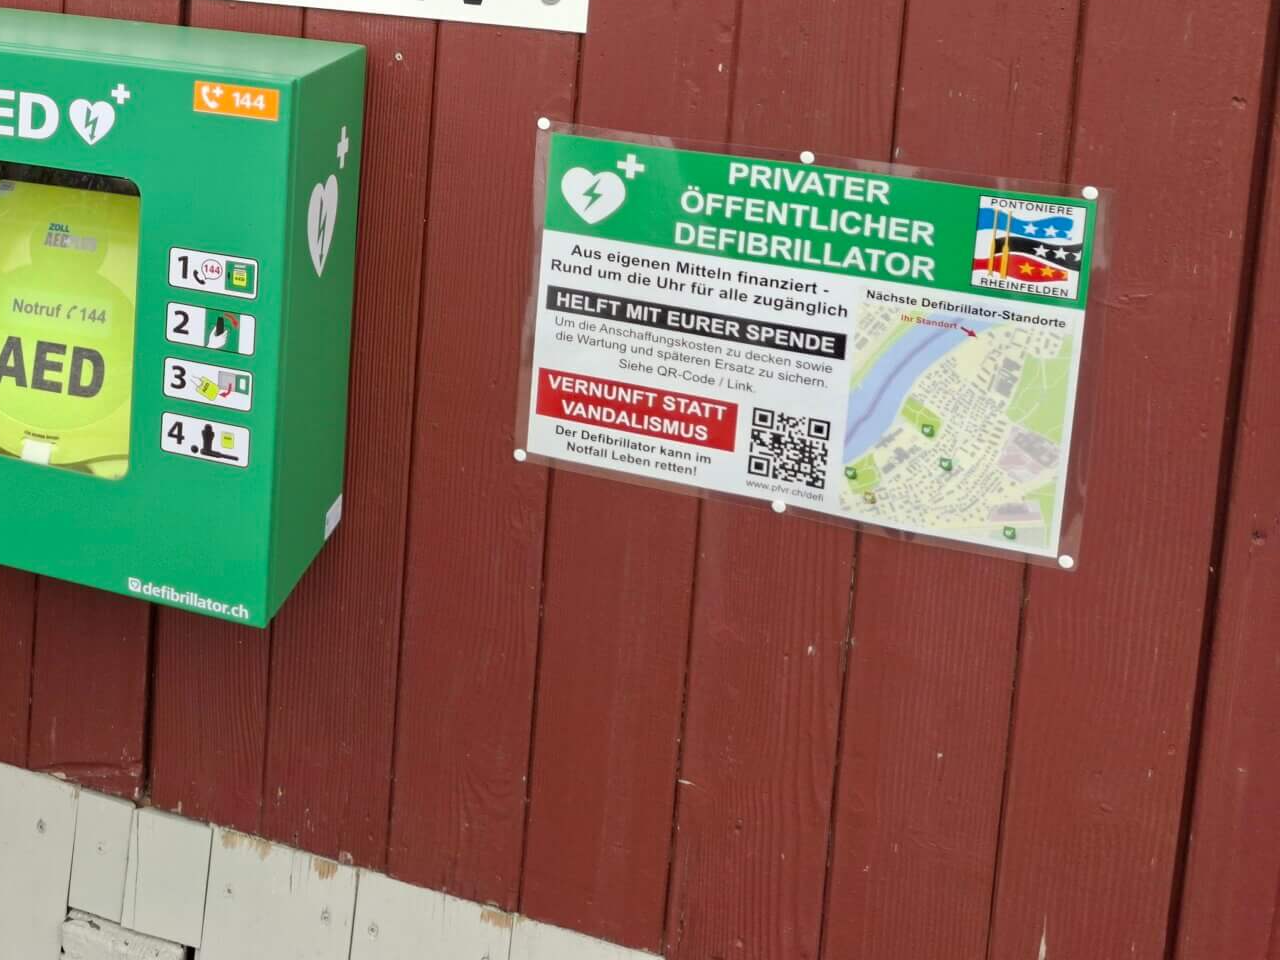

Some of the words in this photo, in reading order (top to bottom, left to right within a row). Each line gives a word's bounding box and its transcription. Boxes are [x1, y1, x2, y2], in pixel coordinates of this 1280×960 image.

[232, 91, 266, 110] 144
[728, 162, 890, 205] PRIVATER
[680, 185, 935, 247] ÖFFENTLICHER
[990, 198, 1074, 216] PONTONIERE
[178, 255, 189, 279] 1
[204, 263, 221, 275] 144
[571, 245, 602, 260] Aus
[607, 251, 670, 273] eigenen
[677, 260, 732, 281] Mitteln
[737, 271, 818, 294] finanziert
[674, 222, 936, 282] DEFIBRILLATOR
[551, 259, 592, 276] Rund
[598, 268, 621, 281] um
[627, 271, 651, 286] die
[657, 275, 686, 291] Uhr
[691, 282, 713, 297] für
[719, 286, 748, 302] alle
[753, 293, 848, 318] zugänglich
[980, 278, 1069, 297] RHEINFELDEN
[12, 298, 62, 318] Notruf
[80, 308, 107, 324] 144
[173, 310, 189, 334] 2
[556, 292, 621, 316] HELFT
[625, 302, 662, 323] MIT
[667, 310, 740, 338] EURER
[745, 325, 836, 353] SPENDE
[866, 289, 918, 307] Nächste
[922, 297, 1067, 328] Defibrillator-Standorte
[916, 316, 959, 330] Standort
[554, 316, 575, 329] Um
[578, 320, 596, 332] die
[599, 322, 722, 355] Anschaffungskosten
[726, 346, 741, 357] zu
[744, 347, 791, 365] decken
[795, 359, 833, 374] sowie
[555, 330, 573, 342] die
[577, 333, 627, 353] Wartung
[630, 341, 653, 356] und
[657, 346, 711, 368] späteren
[715, 359, 754, 376] Ersatz
[758, 368, 773, 378] zu
[777, 369, 828, 388] sichern.
[170, 365, 187, 389] 3
[619, 358, 654, 374] Siehe
[657, 364, 716, 387] QR-Code
[548, 374, 658, 408] VERNUNFT
[662, 394, 727, 421] STATT
[167, 421, 185, 445] 4
[561, 400, 709, 441] VANDALISMUS
[555, 425, 577, 438] Der
[581, 429, 656, 455] Defibrillator
[660, 446, 692, 462] kann
[696, 451, 712, 465] im
[566, 442, 608, 459] Notfall
[611, 449, 651, 469] Leben
[655, 460, 698, 476] retten!
[143, 582, 249, 620] defibrillator.ch
